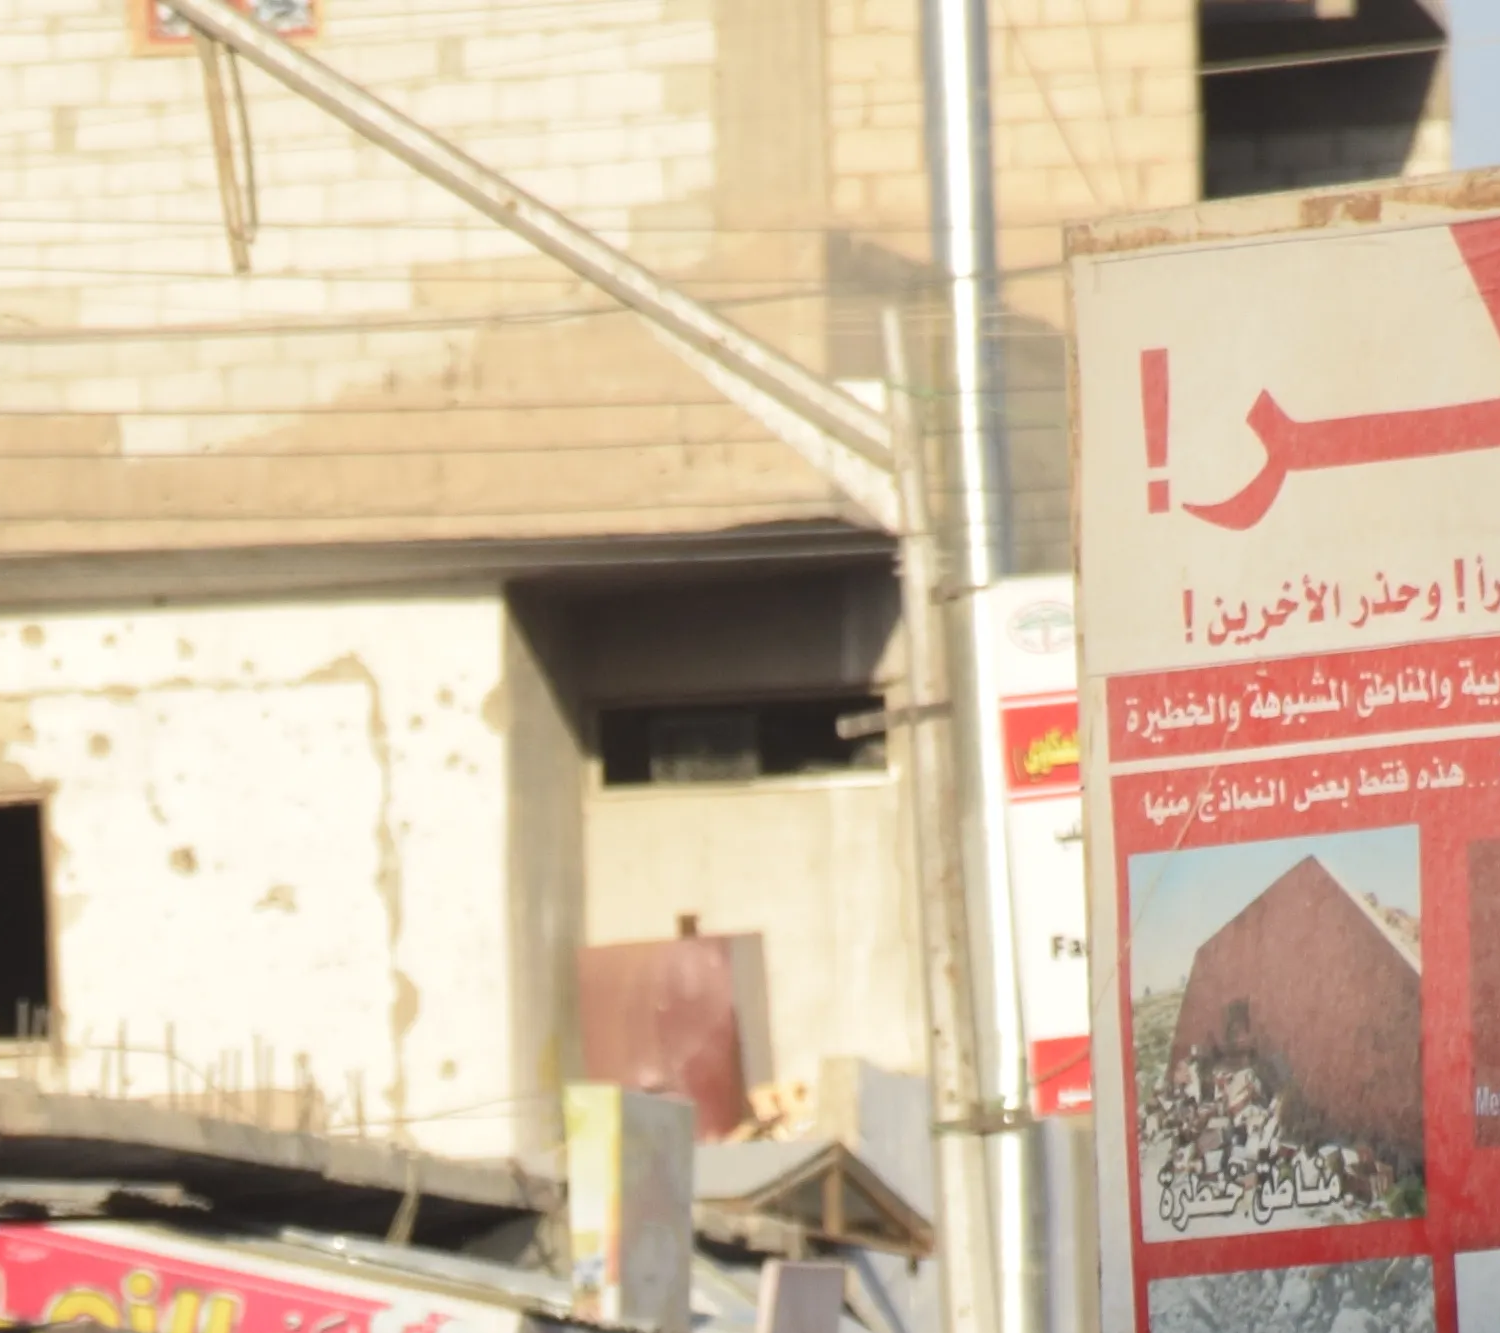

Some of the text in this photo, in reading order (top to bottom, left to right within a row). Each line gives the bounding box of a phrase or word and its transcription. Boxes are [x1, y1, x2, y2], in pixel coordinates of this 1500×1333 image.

[1349, 572, 1442, 628] وحذر
[1126, 692, 1241, 744] والخطيرة
[1248, 667, 1350, 726] المشبوهة
[1355, 665, 1453, 720] والمناطق
[1197, 777, 1286, 822] النماذج
[1293, 770, 1350, 812] بعض
[1357, 760, 1411, 797] فقط
[1144, 791, 1190, 826] منها
[1252, 1150, 1342, 1225] مناطق
